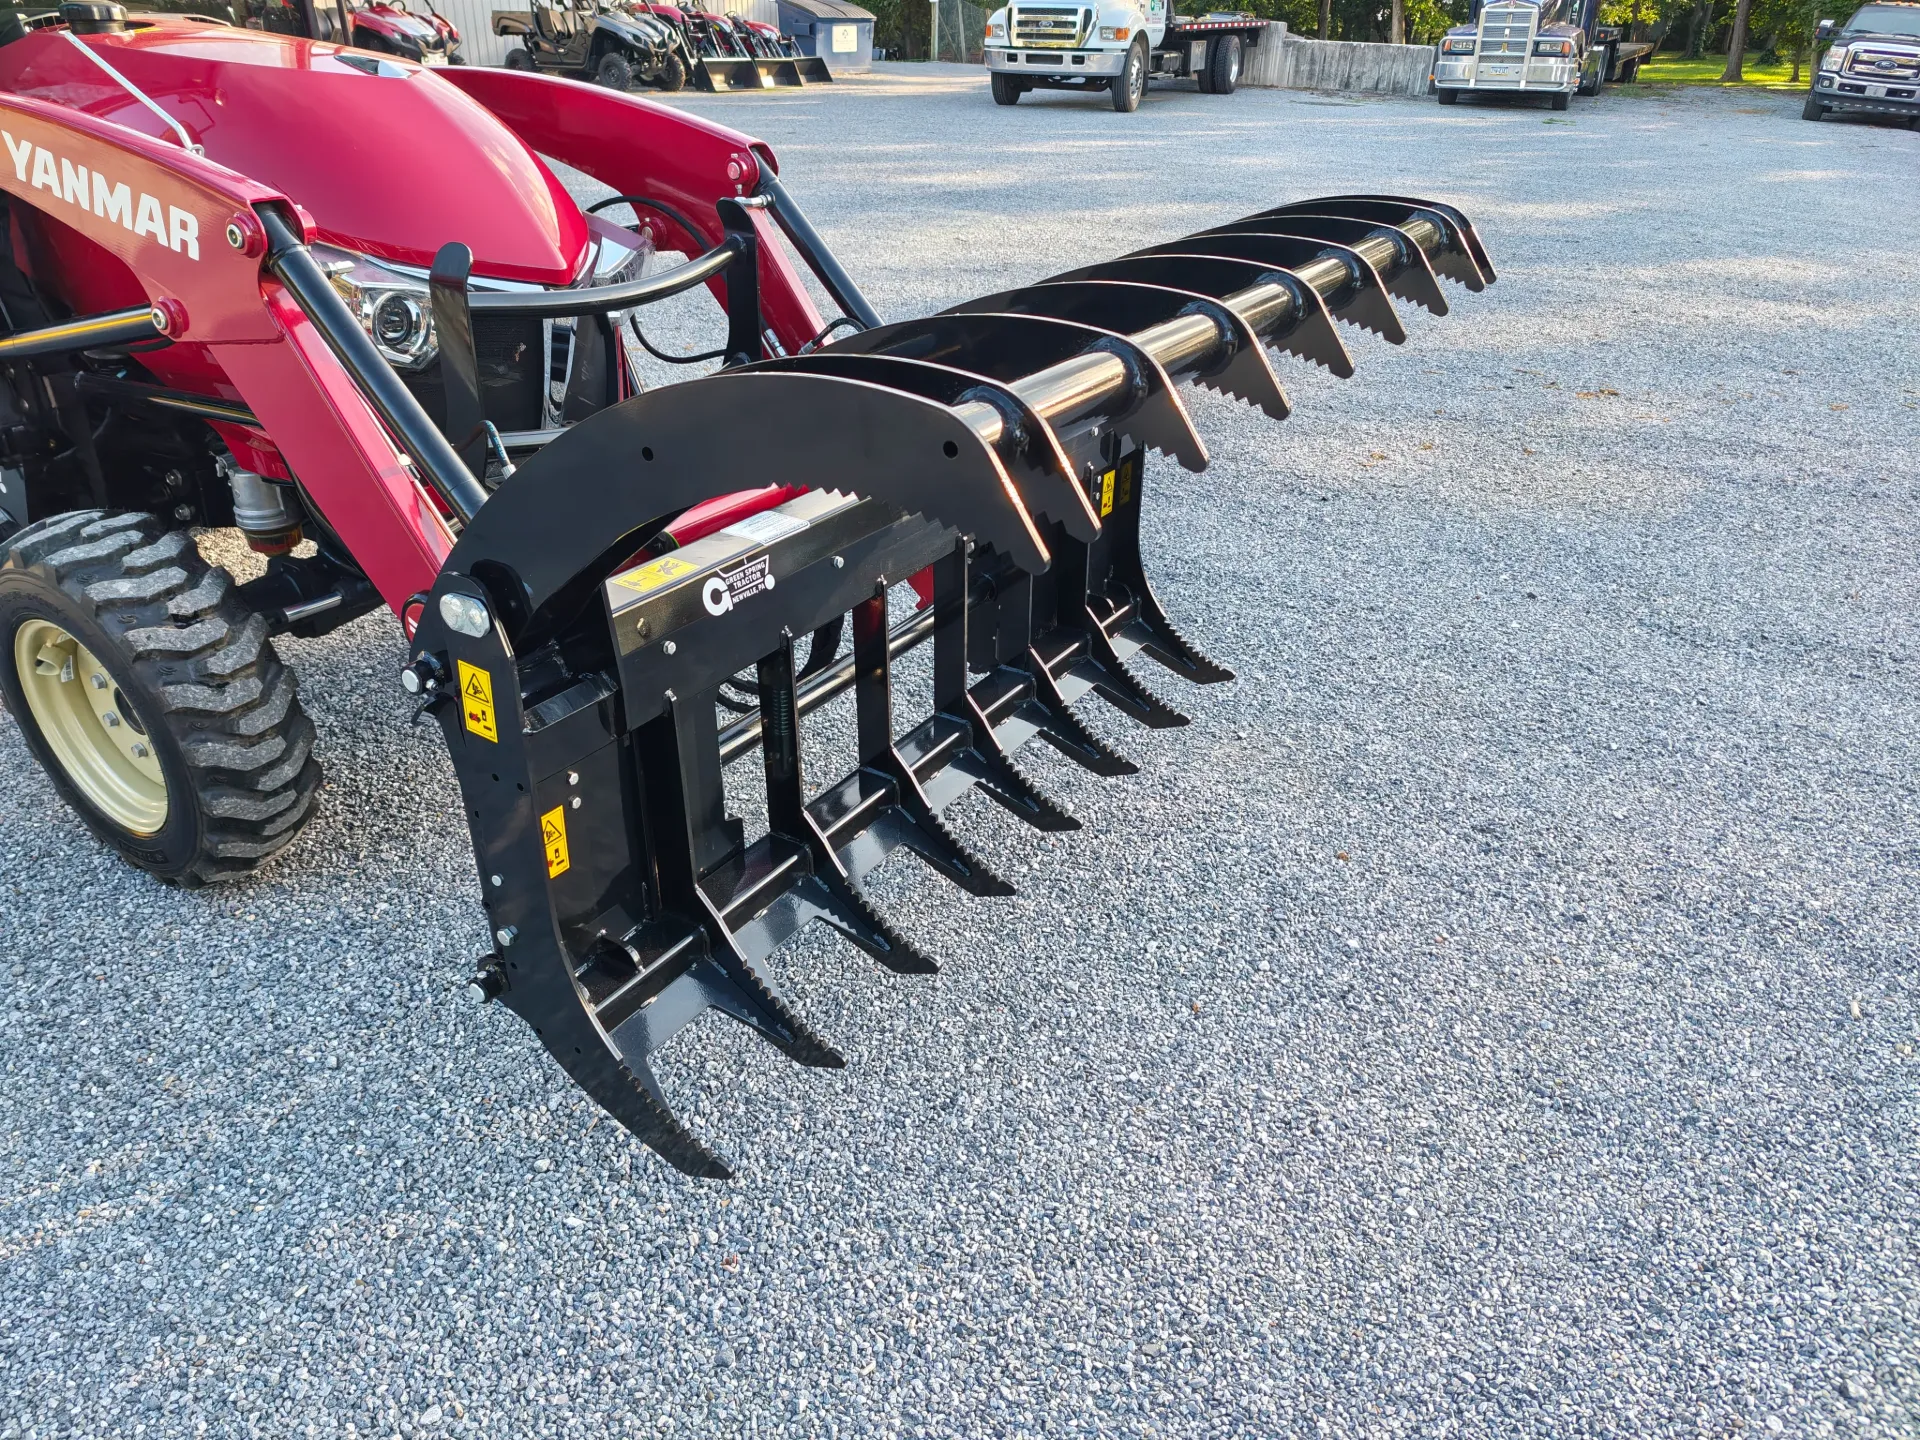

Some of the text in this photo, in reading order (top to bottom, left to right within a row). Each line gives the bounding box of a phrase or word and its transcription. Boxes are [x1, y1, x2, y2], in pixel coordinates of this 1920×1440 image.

[1, 130, 200, 261] YANMAR
[725, 562, 765, 585] GREEN SPRING
[733, 572, 761, 589] TRACTOR
